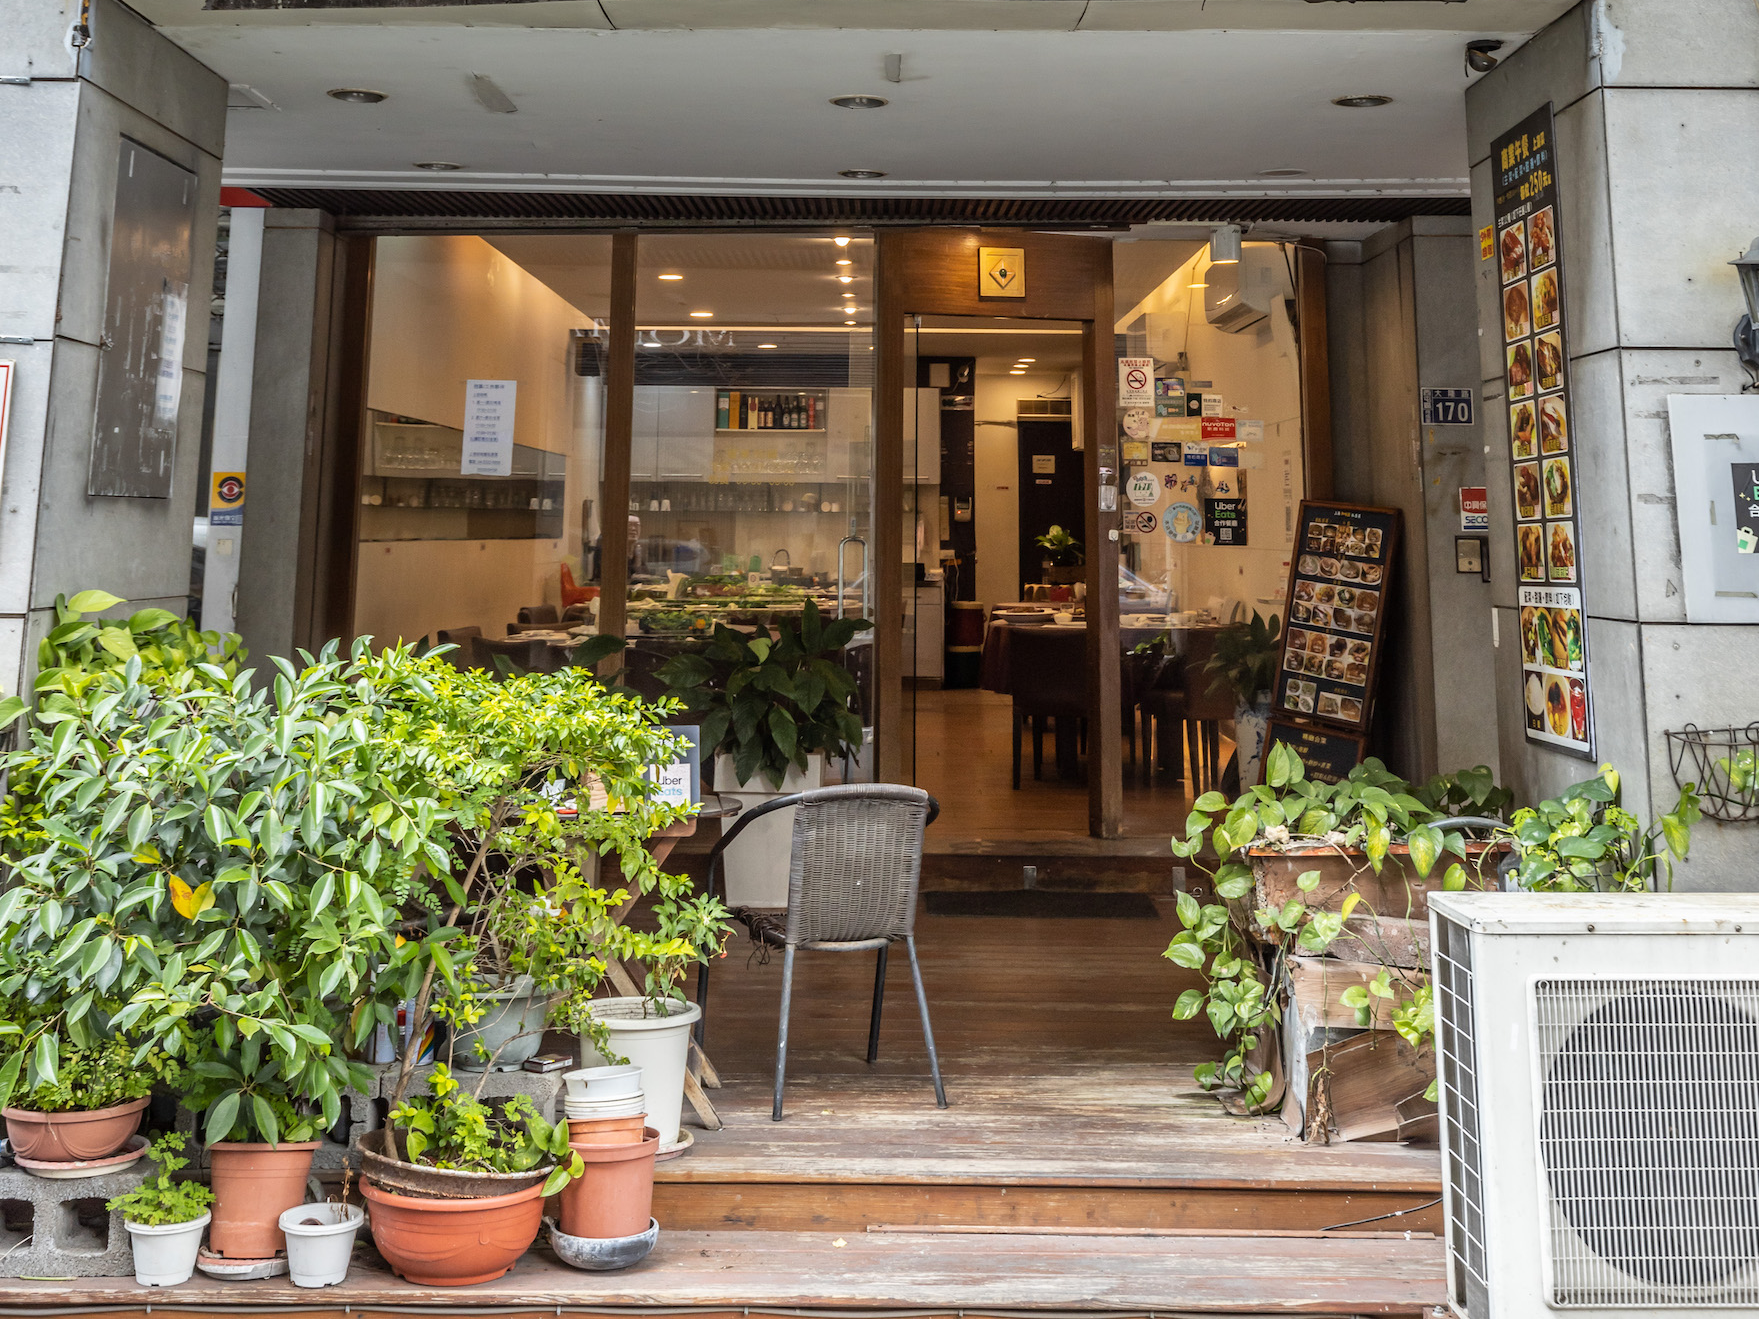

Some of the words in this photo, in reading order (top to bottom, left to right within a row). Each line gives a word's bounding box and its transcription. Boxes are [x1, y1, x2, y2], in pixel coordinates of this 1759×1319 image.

[1435, 401, 1469, 422] 170
[1214, 501, 1236, 510] Uber
[1215, 510, 1236, 519] Eats
